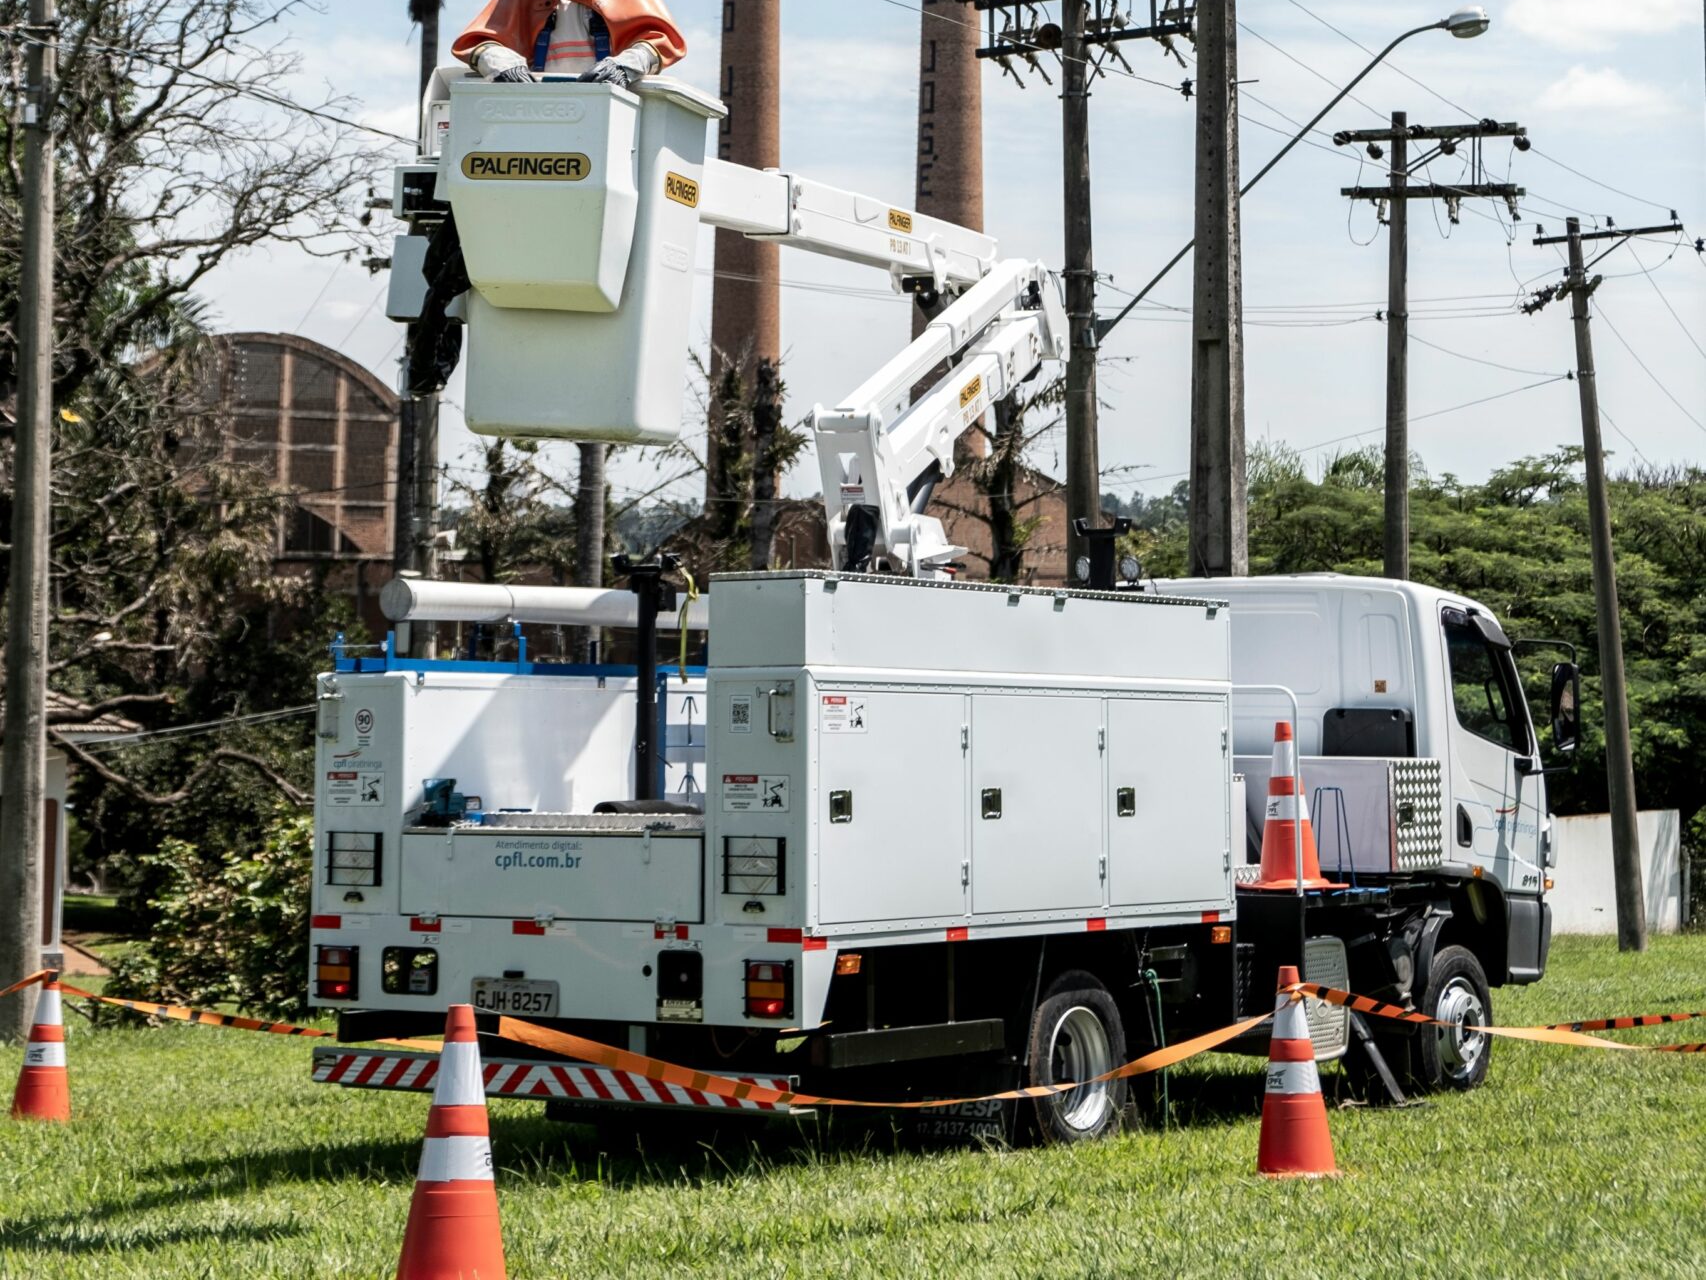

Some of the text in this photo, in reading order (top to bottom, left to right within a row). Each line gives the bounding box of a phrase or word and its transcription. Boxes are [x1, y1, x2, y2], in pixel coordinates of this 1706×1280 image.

[470, 157, 582, 176] PALFINGER
[666, 176, 697, 202] PALFINGER
[358, 714, 371, 726] 90
[495, 841, 549, 850] Atendimento
[495, 851, 582, 870] cpfl.com.br
[919, 1096, 1002, 1117] ENVESP
